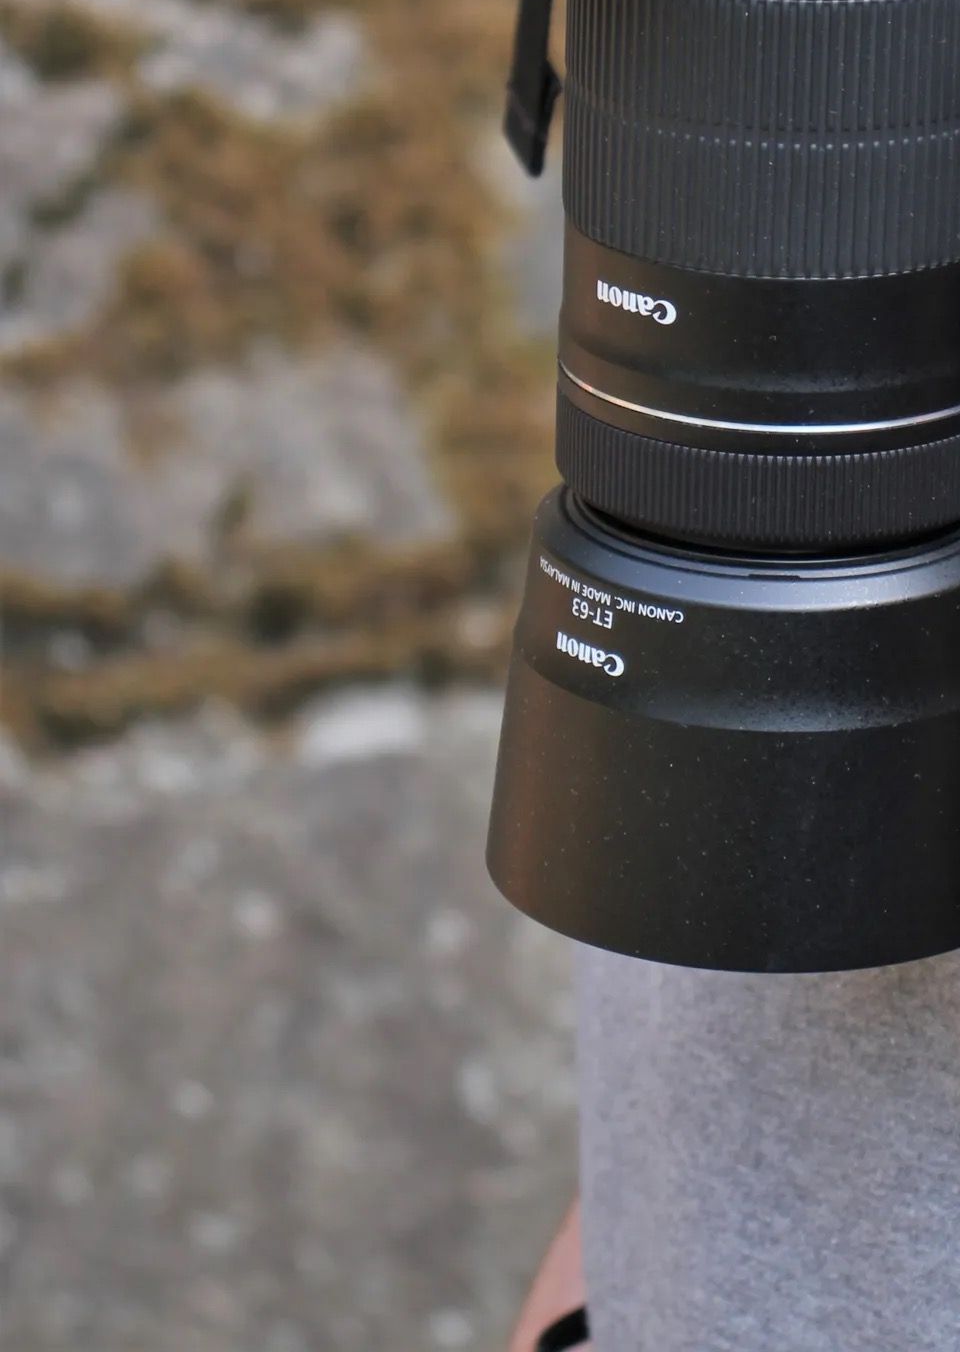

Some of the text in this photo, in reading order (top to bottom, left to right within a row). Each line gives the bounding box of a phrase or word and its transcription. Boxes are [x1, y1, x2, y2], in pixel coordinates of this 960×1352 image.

[596, 279, 677, 325] Canon
[539, 555, 684, 623] CANON INC. MADE IN MALAYSIA
[571, 598, 614, 630] ET-63
[556, 631, 625, 677] Canon
